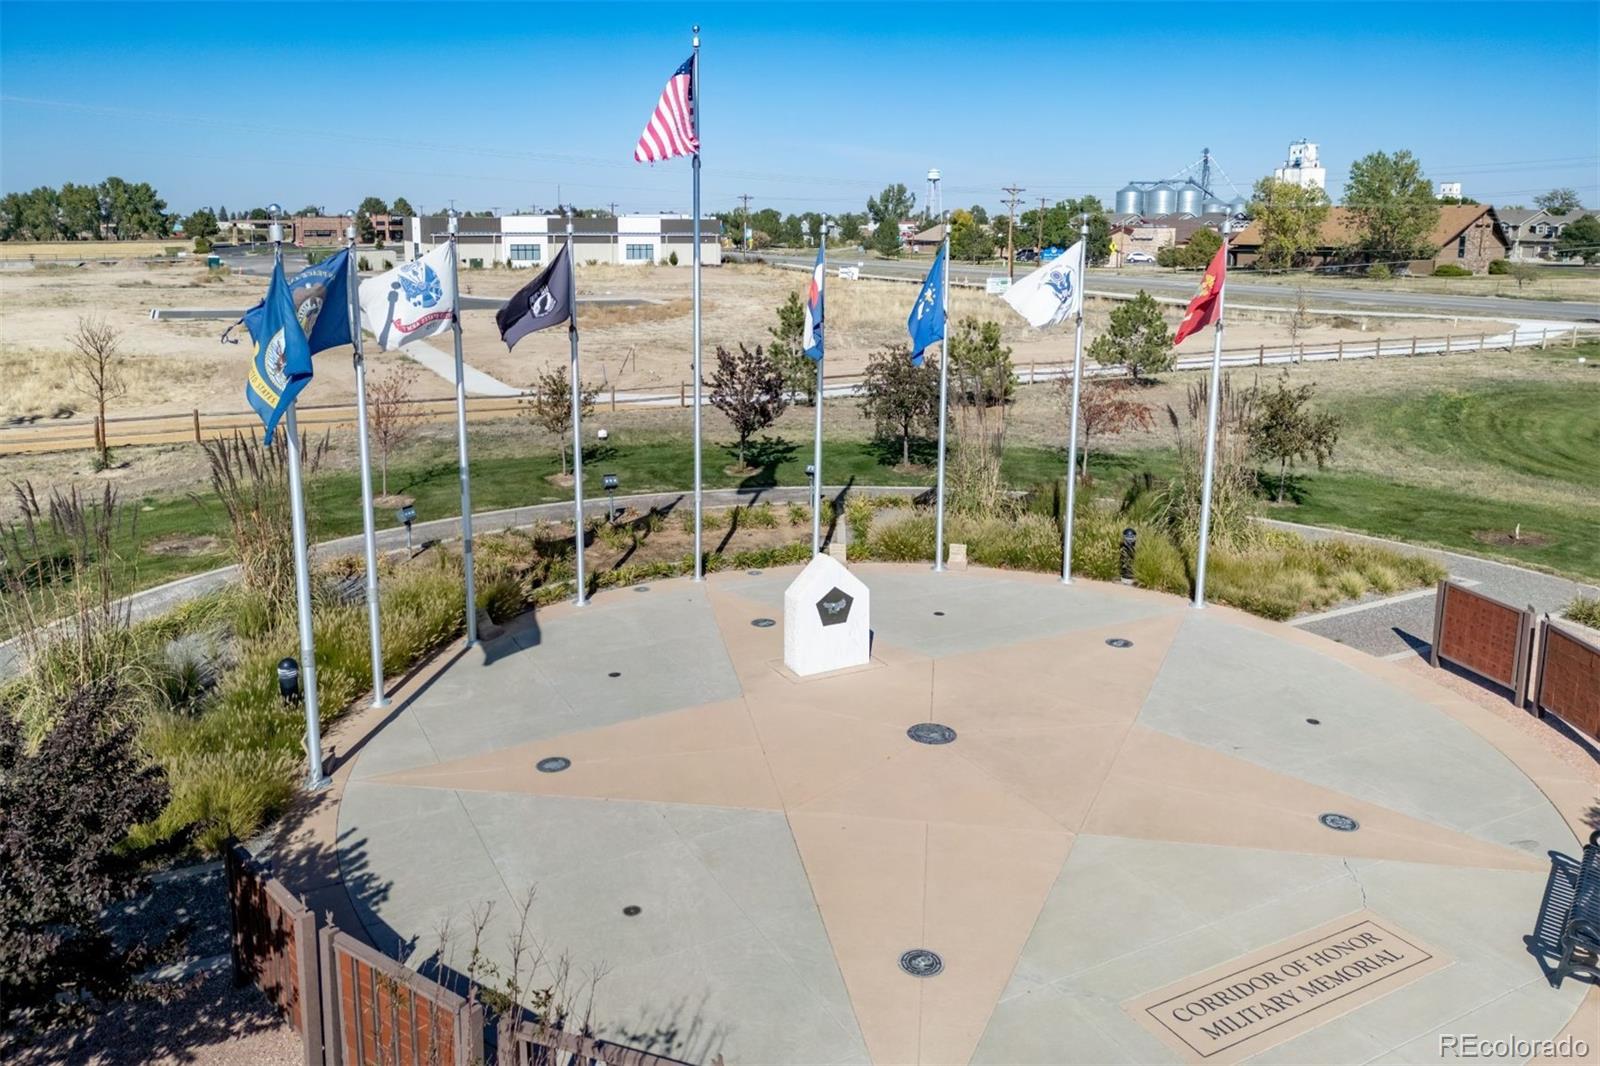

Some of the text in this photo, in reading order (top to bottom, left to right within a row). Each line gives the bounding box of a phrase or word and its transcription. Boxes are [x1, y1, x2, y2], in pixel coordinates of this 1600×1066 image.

[1172, 932, 1383, 1022] CORRIDOR OF HONOR
[1199, 949, 1405, 1040] MILITARY MEMORIAL
